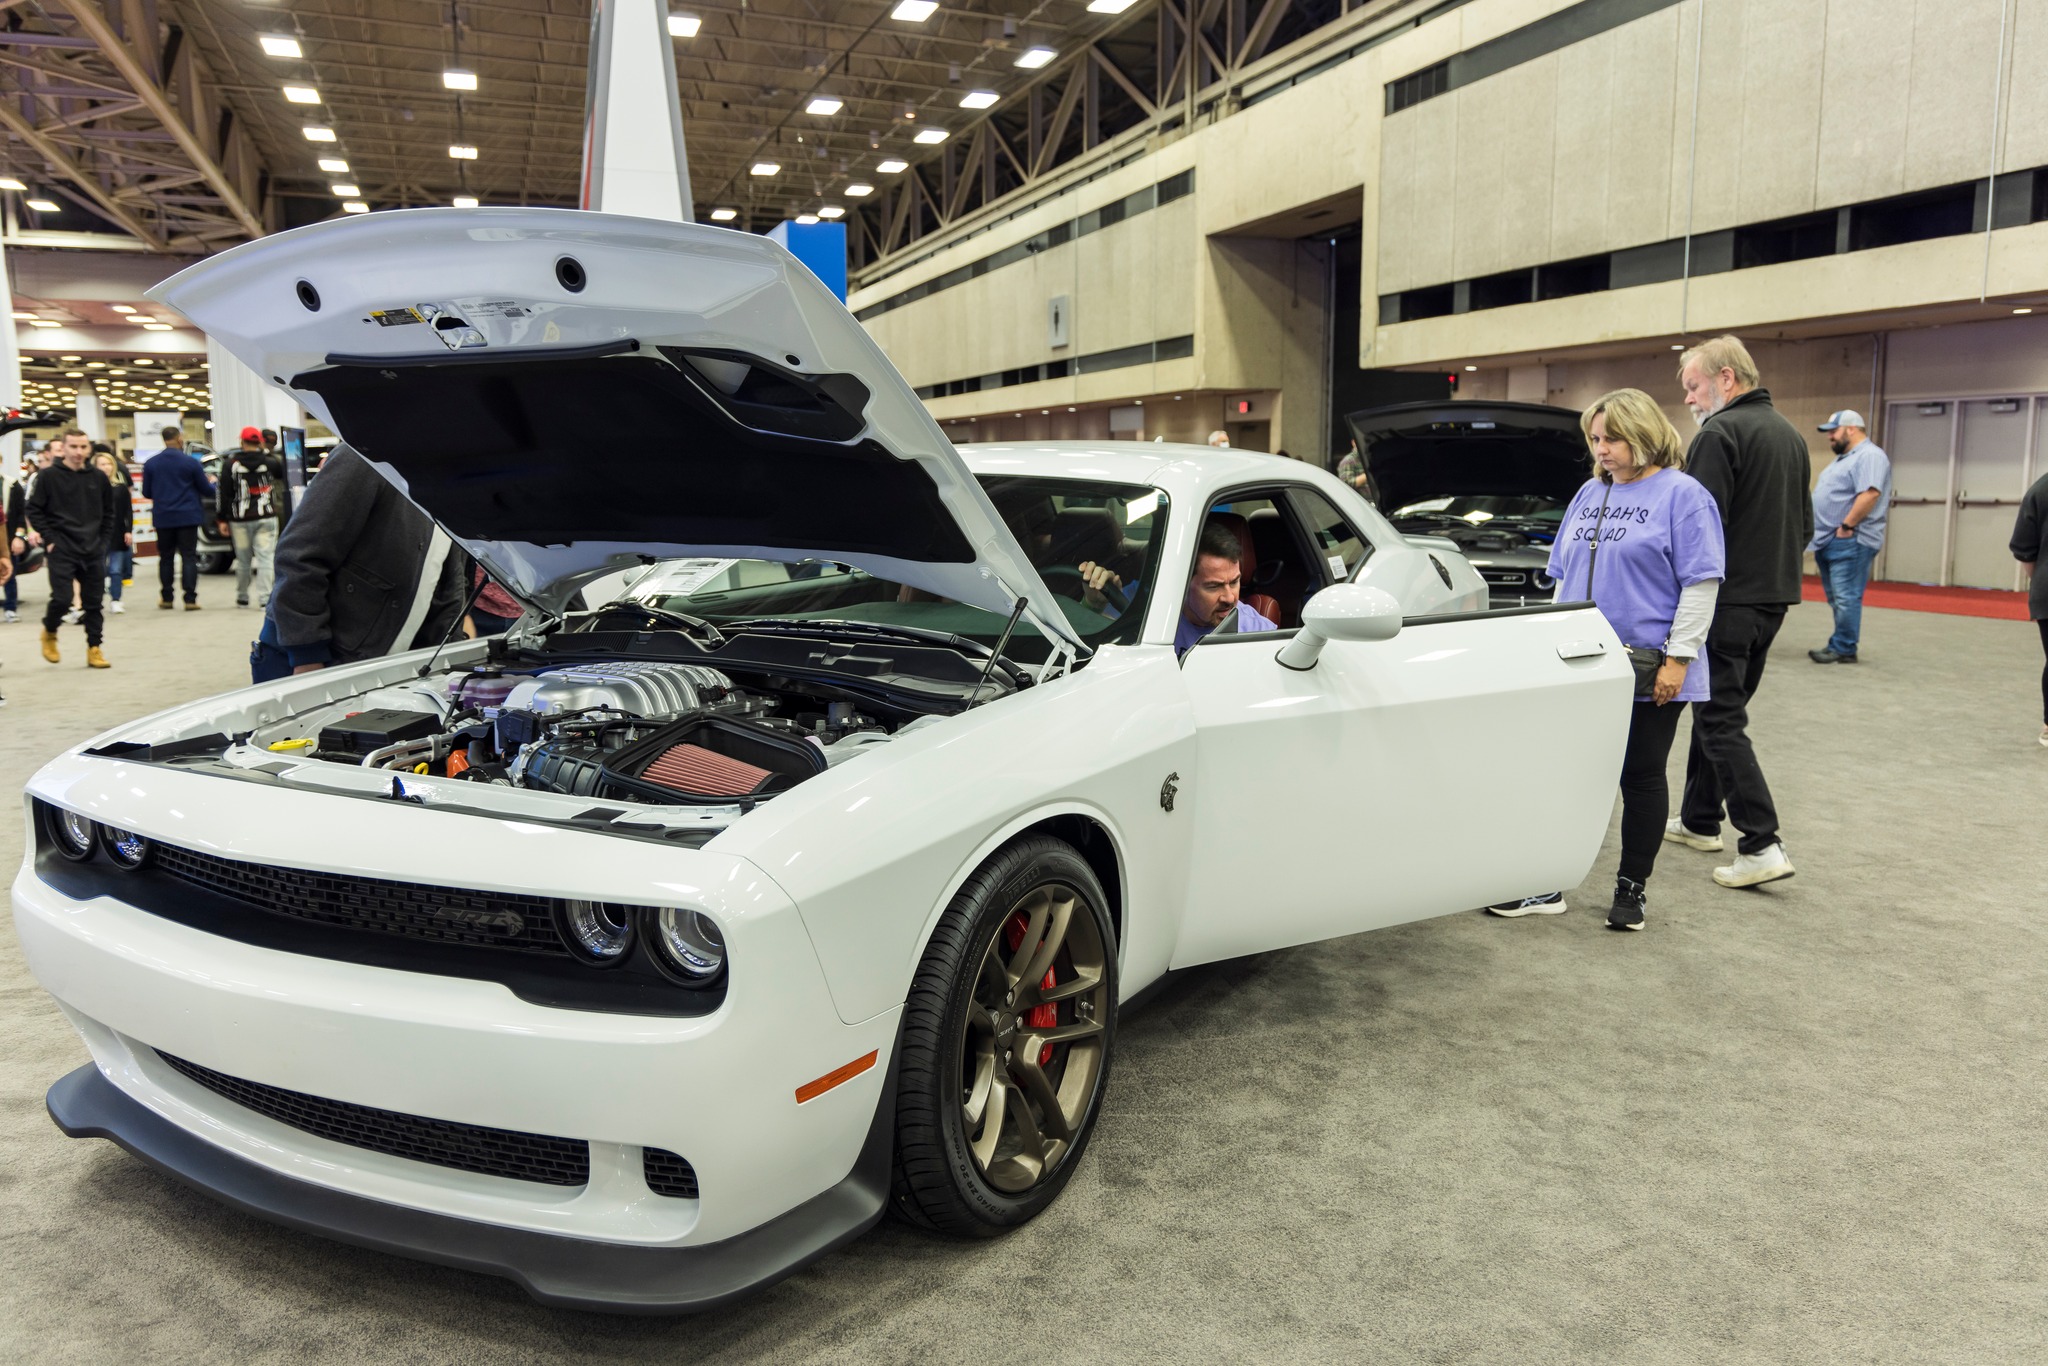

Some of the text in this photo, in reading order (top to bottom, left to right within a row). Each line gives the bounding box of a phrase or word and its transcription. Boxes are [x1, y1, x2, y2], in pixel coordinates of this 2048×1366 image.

[1579, 506, 1649, 524] SARAH'S
[1572, 527, 1627, 543] SQUAD
[960, 1164, 970, 1179] 20
